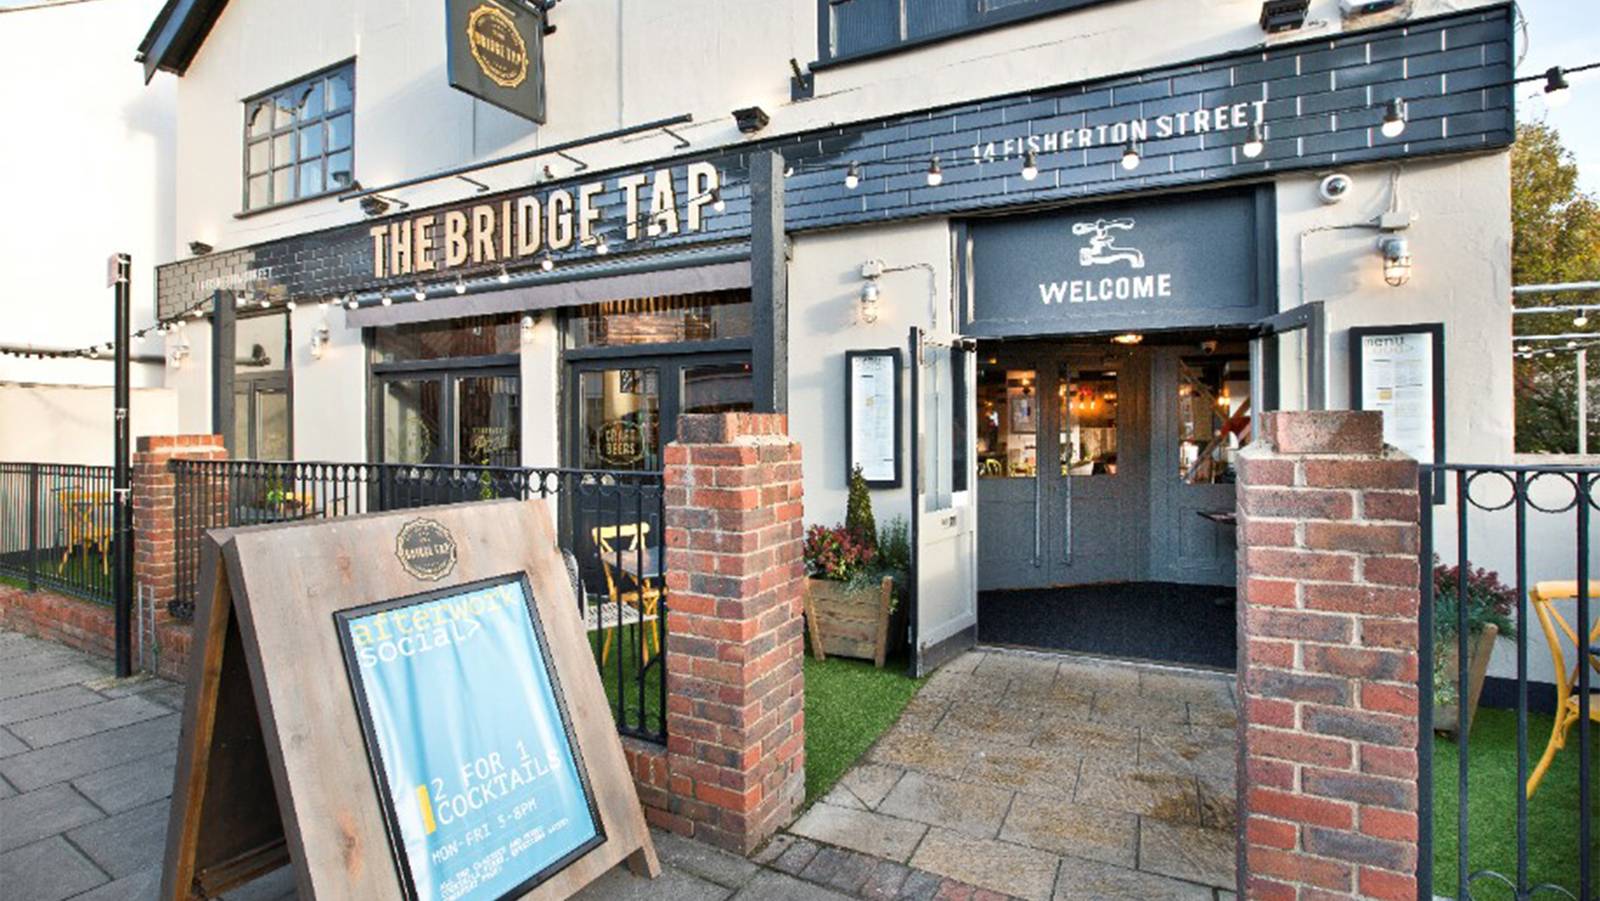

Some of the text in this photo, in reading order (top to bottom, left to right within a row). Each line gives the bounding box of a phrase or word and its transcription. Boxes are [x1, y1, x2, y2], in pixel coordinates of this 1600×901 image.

[972, 100, 1267, 165] 14 FISHERTON STREET
[370, 160, 722, 278] THE BRIDGE TAP
[1038, 273, 1172, 304] WELCOME
[605, 442, 636, 456] BEERS
[353, 585, 517, 646] afterwork
[431, 739, 531, 804] 2 FOR 1
[437, 750, 562, 826] COCKTAILS
[431, 823, 493, 865] MON-FRI
[496, 796, 539, 829] 5-8PM
